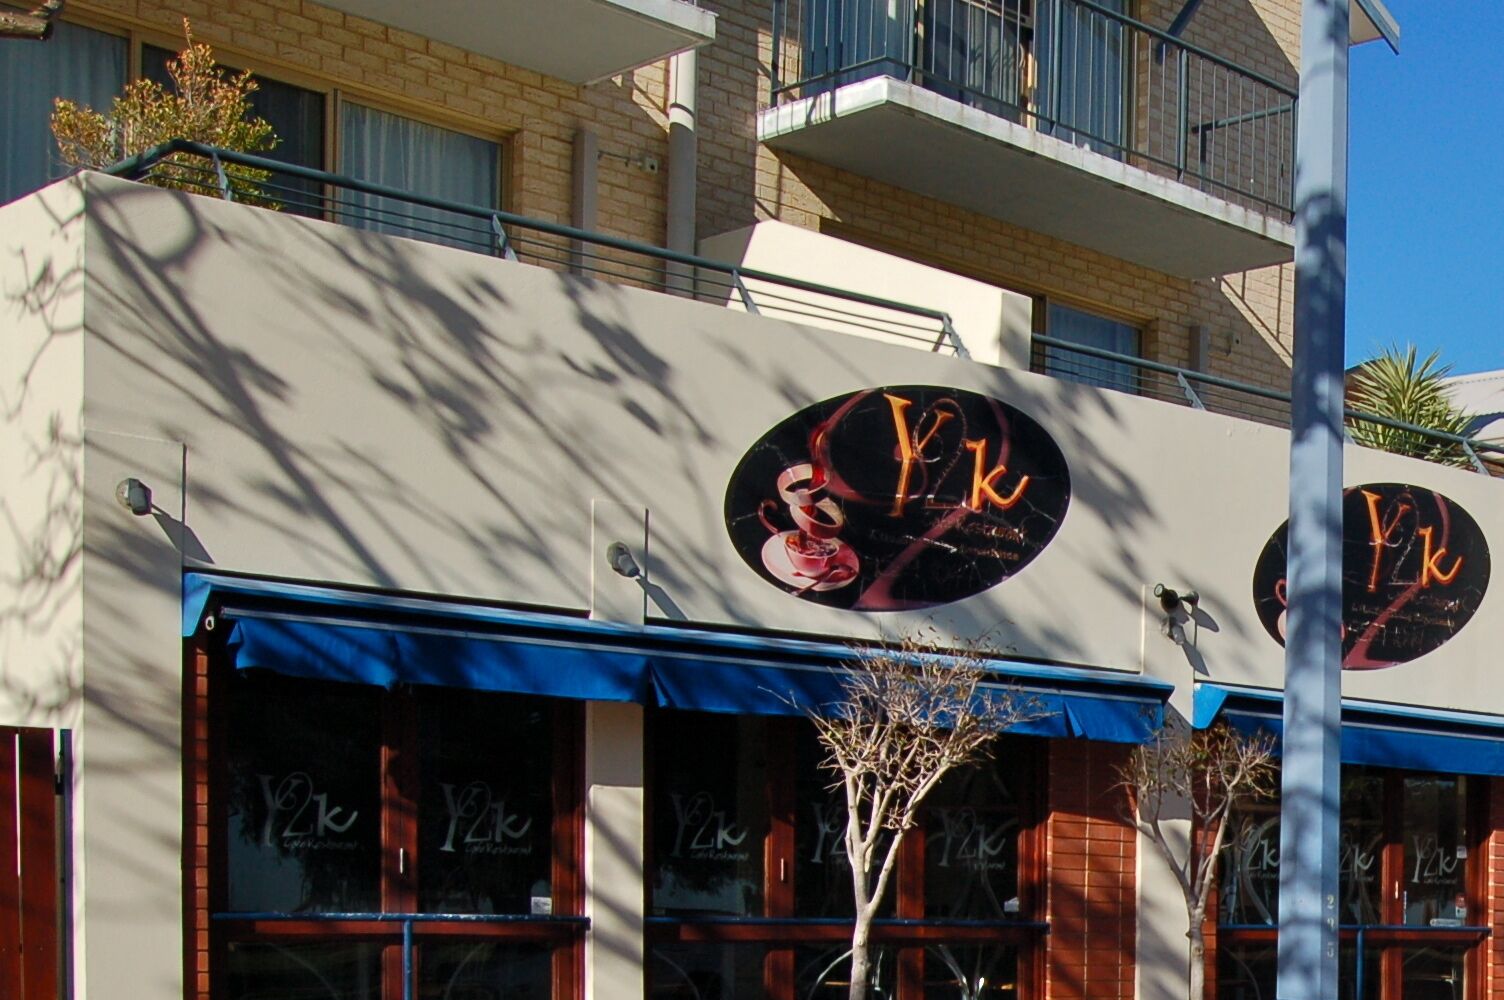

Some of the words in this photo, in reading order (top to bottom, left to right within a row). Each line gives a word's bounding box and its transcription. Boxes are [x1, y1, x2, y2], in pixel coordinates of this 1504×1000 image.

[256, 771, 358, 849] Y2k
[437, 781, 532, 852] Y2k
[669, 791, 751, 858] Y2k
[1411, 832, 1458, 884] Y2k
